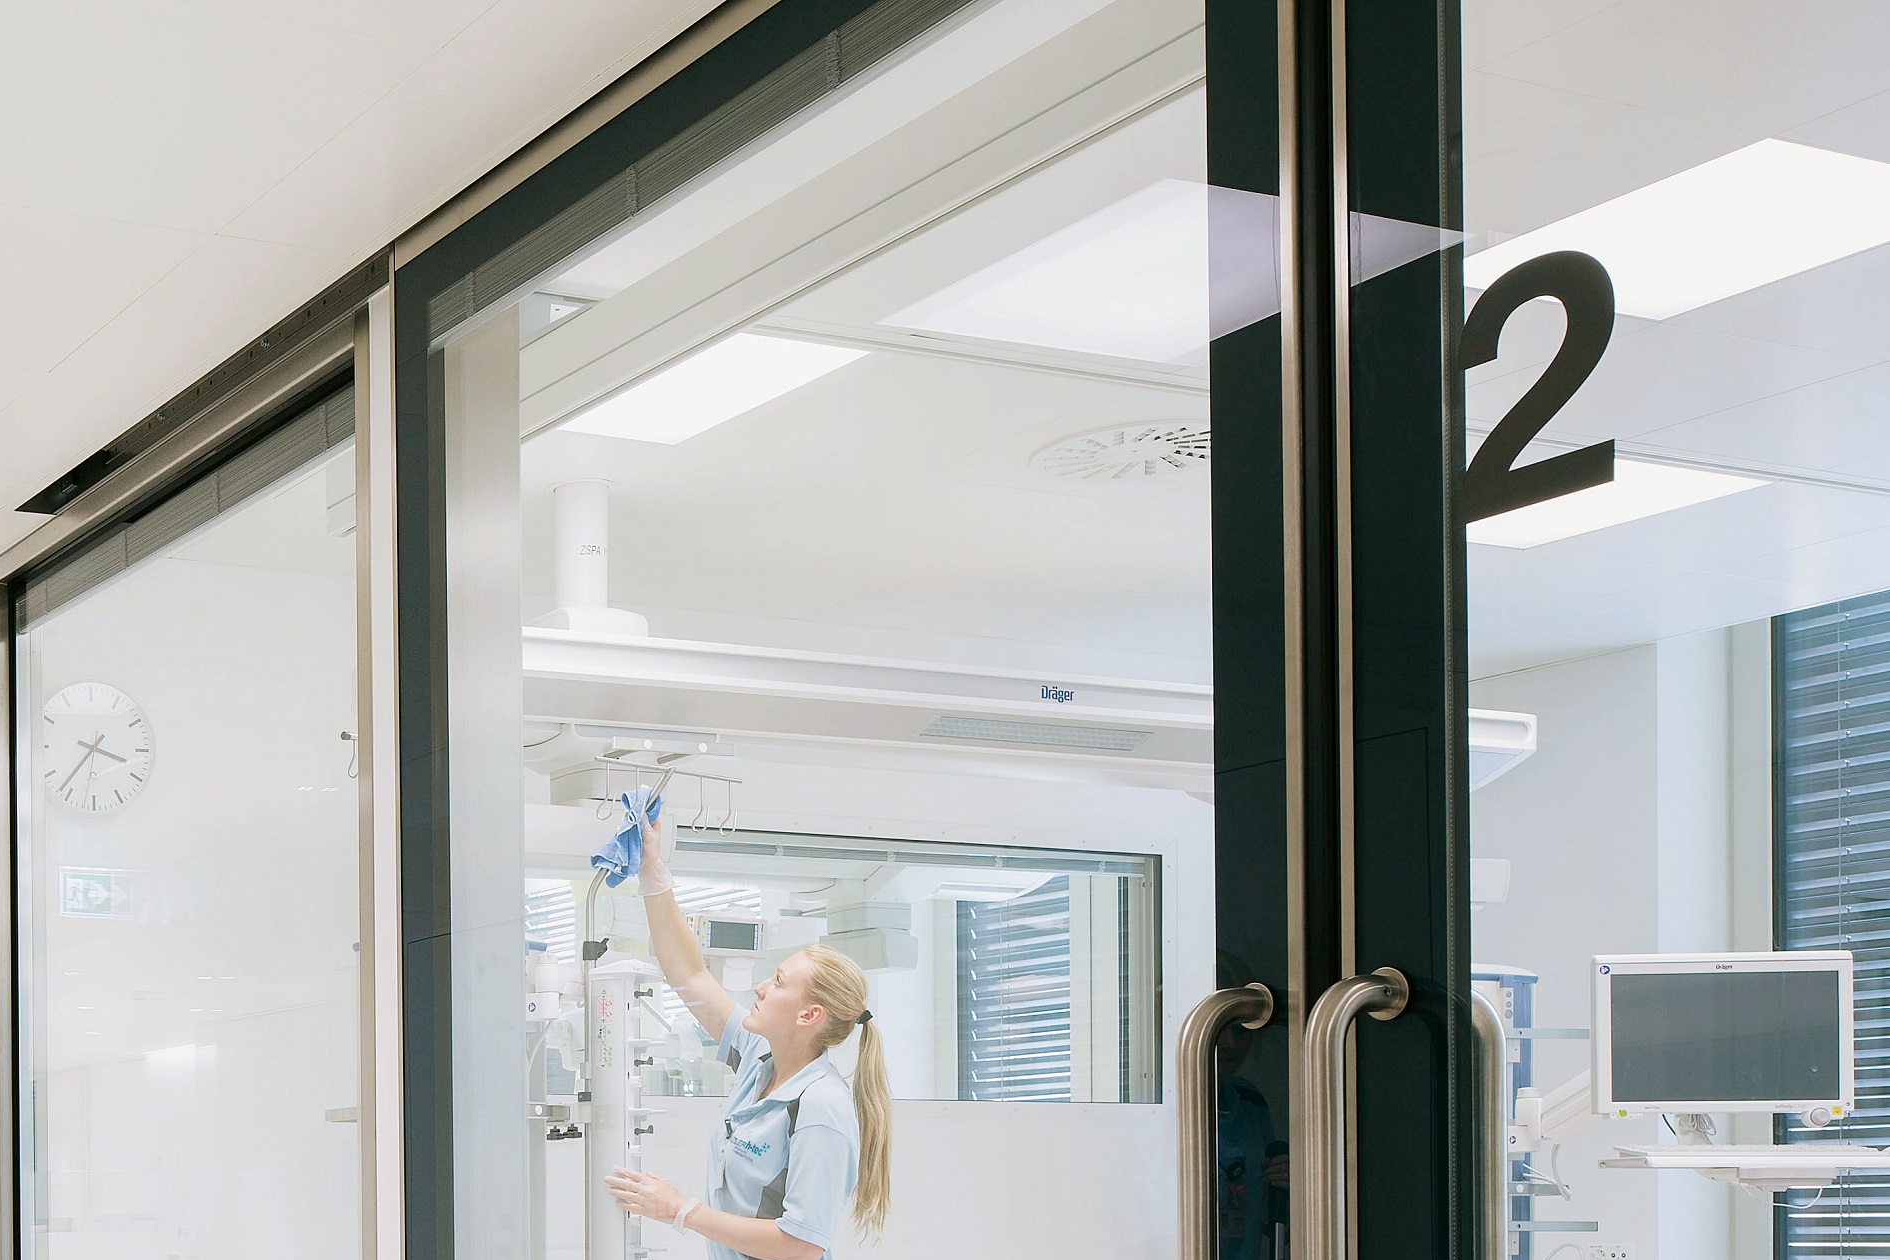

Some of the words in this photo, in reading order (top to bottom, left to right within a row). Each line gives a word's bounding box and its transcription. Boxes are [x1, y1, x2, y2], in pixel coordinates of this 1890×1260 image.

[1455, 250, 1616, 527] 2
[579, 545, 601, 555] ZSPA
[1041, 685, 1075, 703] Dräger
